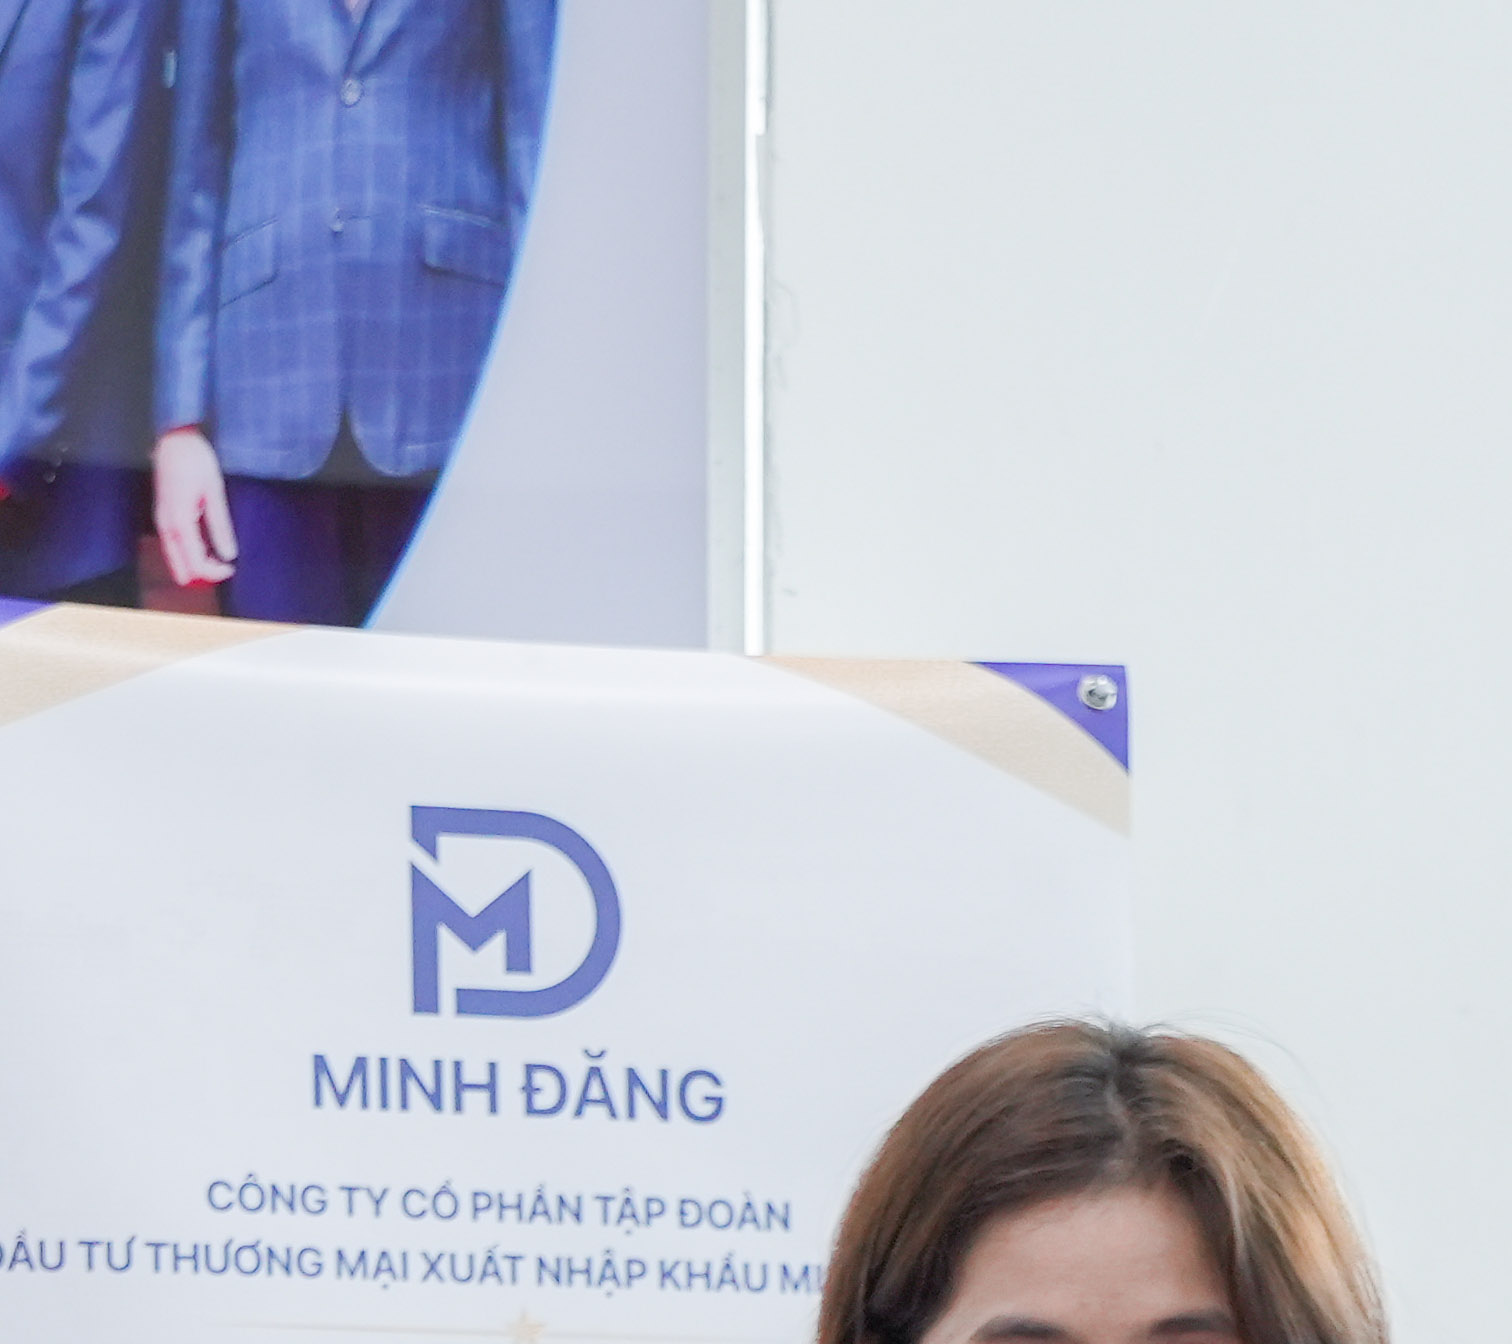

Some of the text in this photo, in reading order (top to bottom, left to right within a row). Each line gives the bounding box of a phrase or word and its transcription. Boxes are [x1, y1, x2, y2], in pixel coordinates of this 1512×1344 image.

[313, 1048, 726, 1124] MINH ĐĂNG
[208, 1173, 792, 1235] CÔNG TY CỔ PHẦN TẬP ĐOÀN
[78, 1236, 137, 1272] TƯ
[146, 1239, 323, 1278] THƯƠNG
[335, 1249, 407, 1288] MẠI
[422, 1244, 525, 1284] XUẤT
[536, 1249, 647, 1297] NHẬP
[658, 1252, 768, 1293] KHẨU
[780, 1263, 825, 1294] MI
